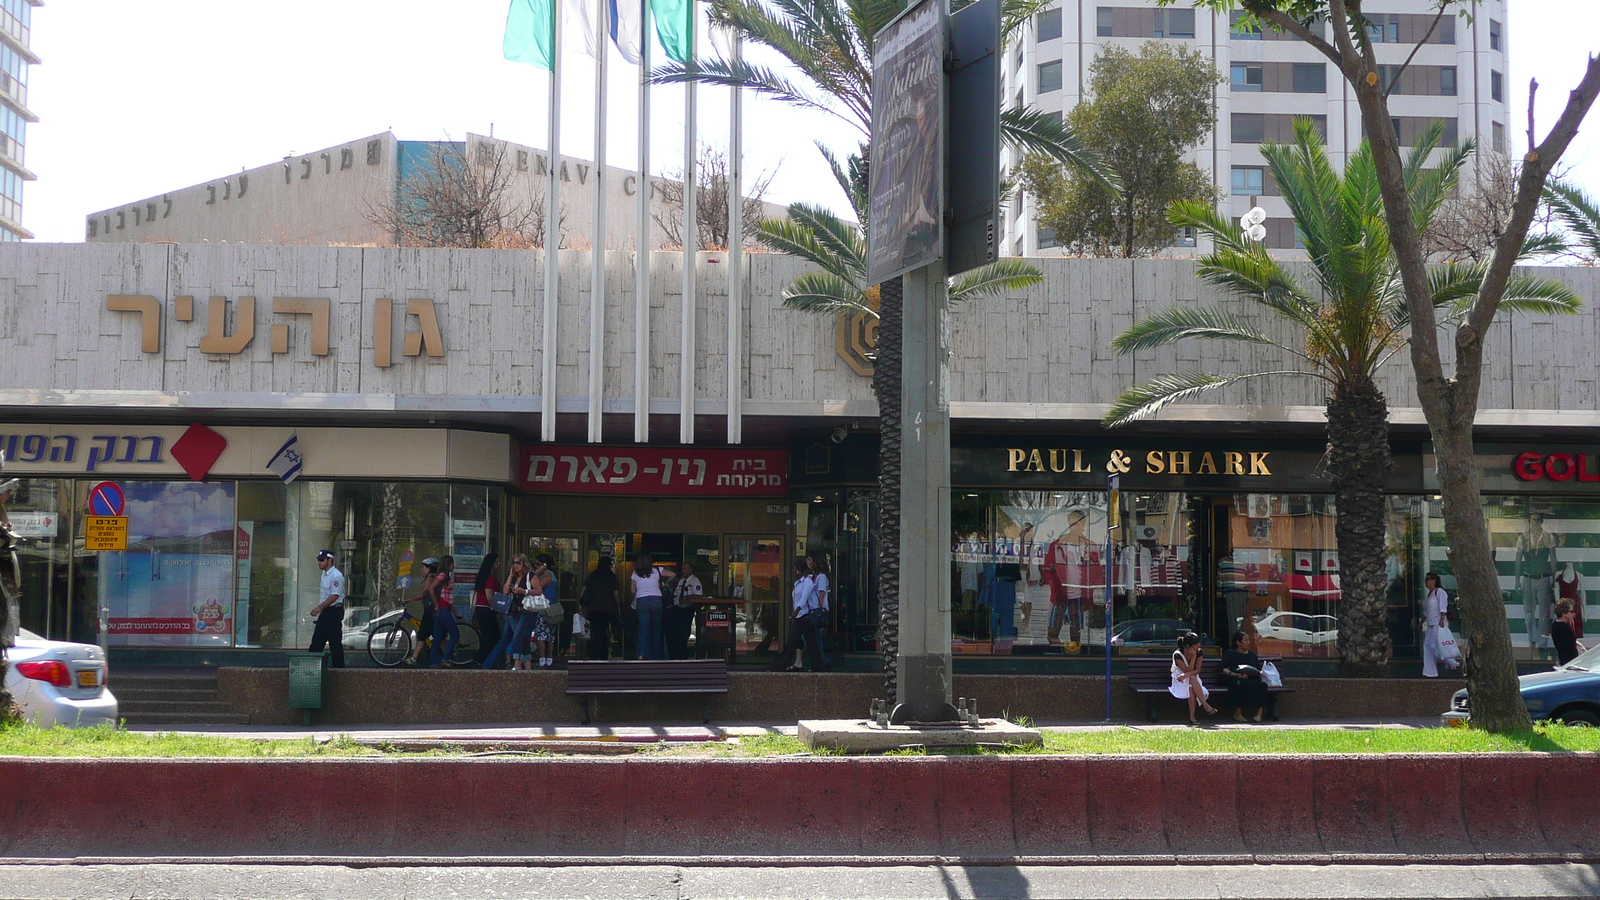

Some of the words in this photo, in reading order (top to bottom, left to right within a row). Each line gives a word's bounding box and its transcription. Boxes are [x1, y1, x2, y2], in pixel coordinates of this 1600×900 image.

[516, 149, 591, 186] ENAV
[206, 172, 249, 205] ענב
[106, 294, 330, 356] העיר
[374, 297, 445, 367] גן
[0, 434, 77, 462] הפו
[86, 435, 164, 472] בנק
[1006, 448, 1092, 474] PAUL
[1105, 448, 1132, 474] &
[1146, 449, 1273, 477] SHARK
[526, 454, 707, 486] ניו-פארם
[716, 472, 782, 488] מרקחת
[732, 458, 767, 471] בית
[1515, 451, 1600, 482] GOL
